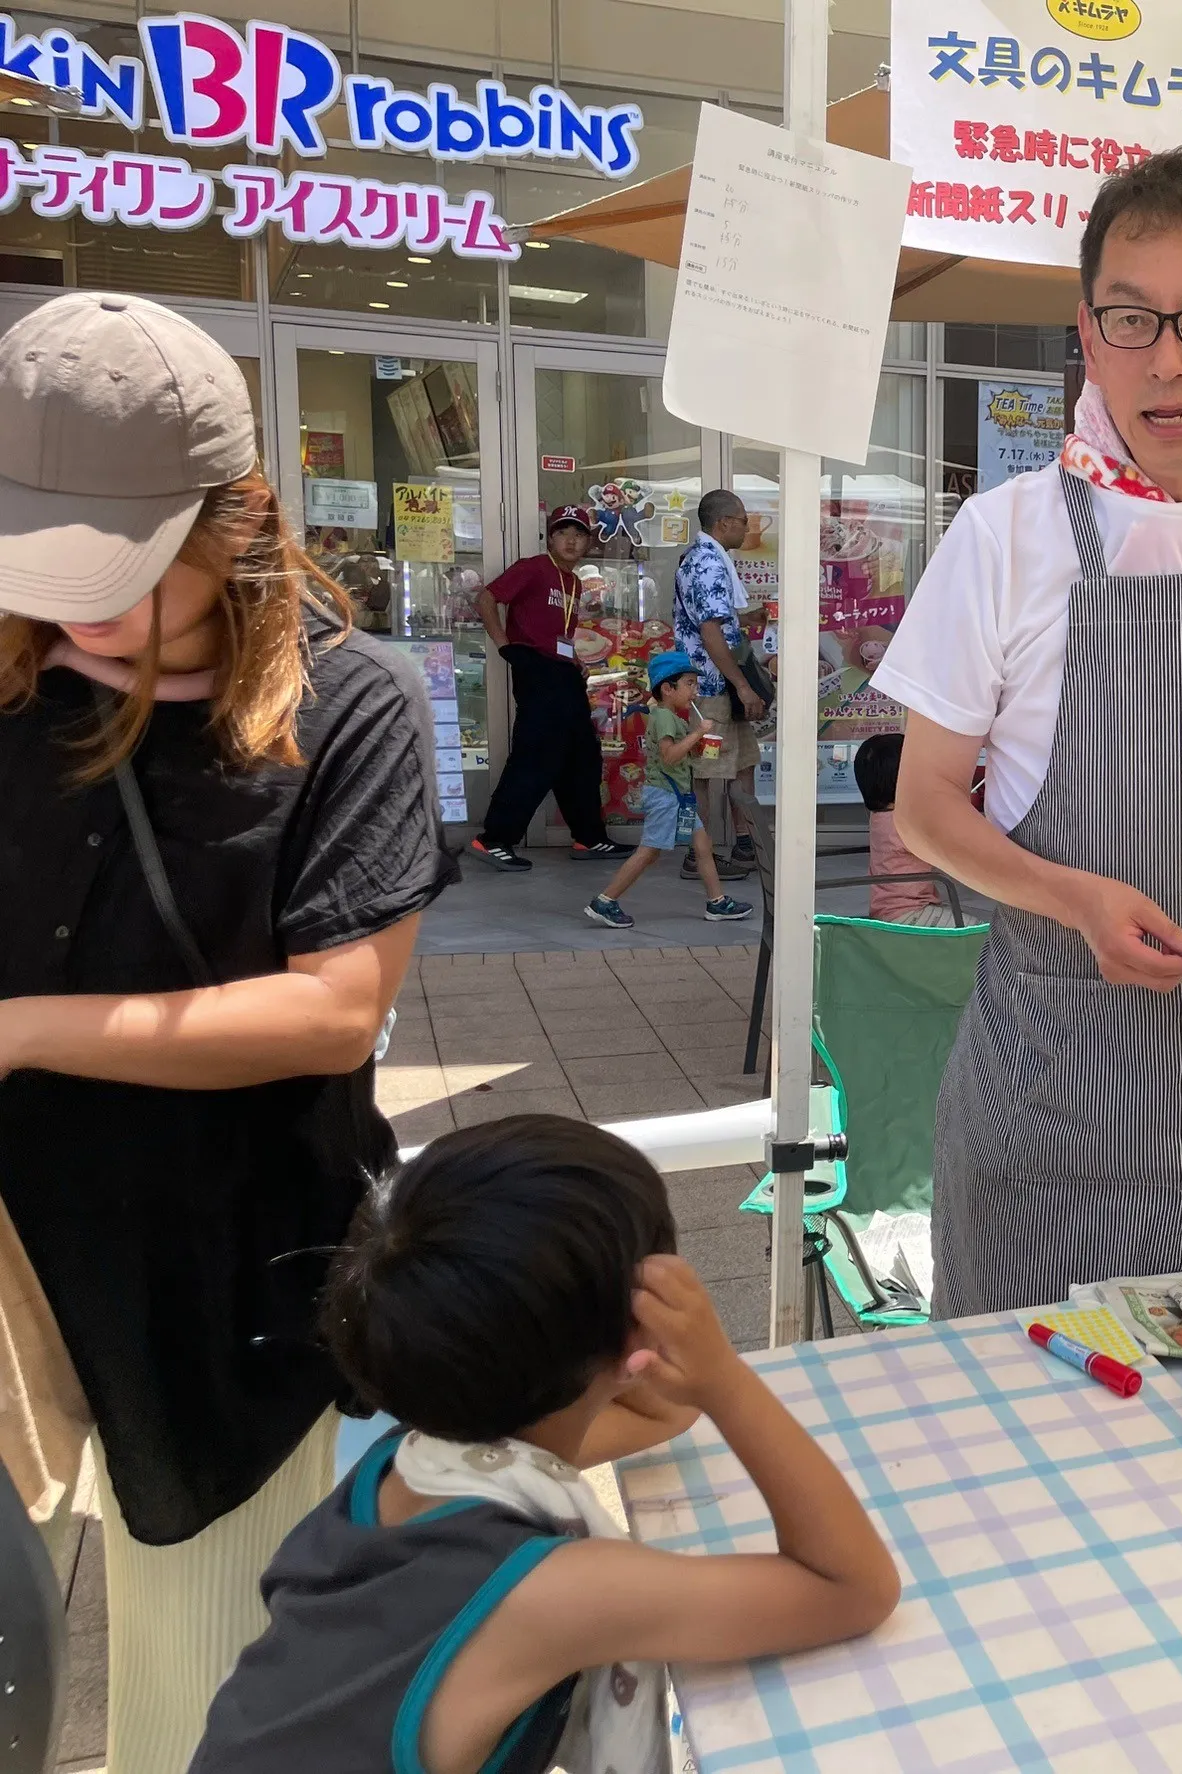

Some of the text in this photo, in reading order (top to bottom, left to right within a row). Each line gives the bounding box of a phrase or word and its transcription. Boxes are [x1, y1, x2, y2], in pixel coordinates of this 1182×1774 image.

[148, 21, 335, 148] BR
[233, 173, 513, 252] アイスクリーム
[995, 397, 1015, 410] TEA
[1020, 399, 1044, 413] Time
